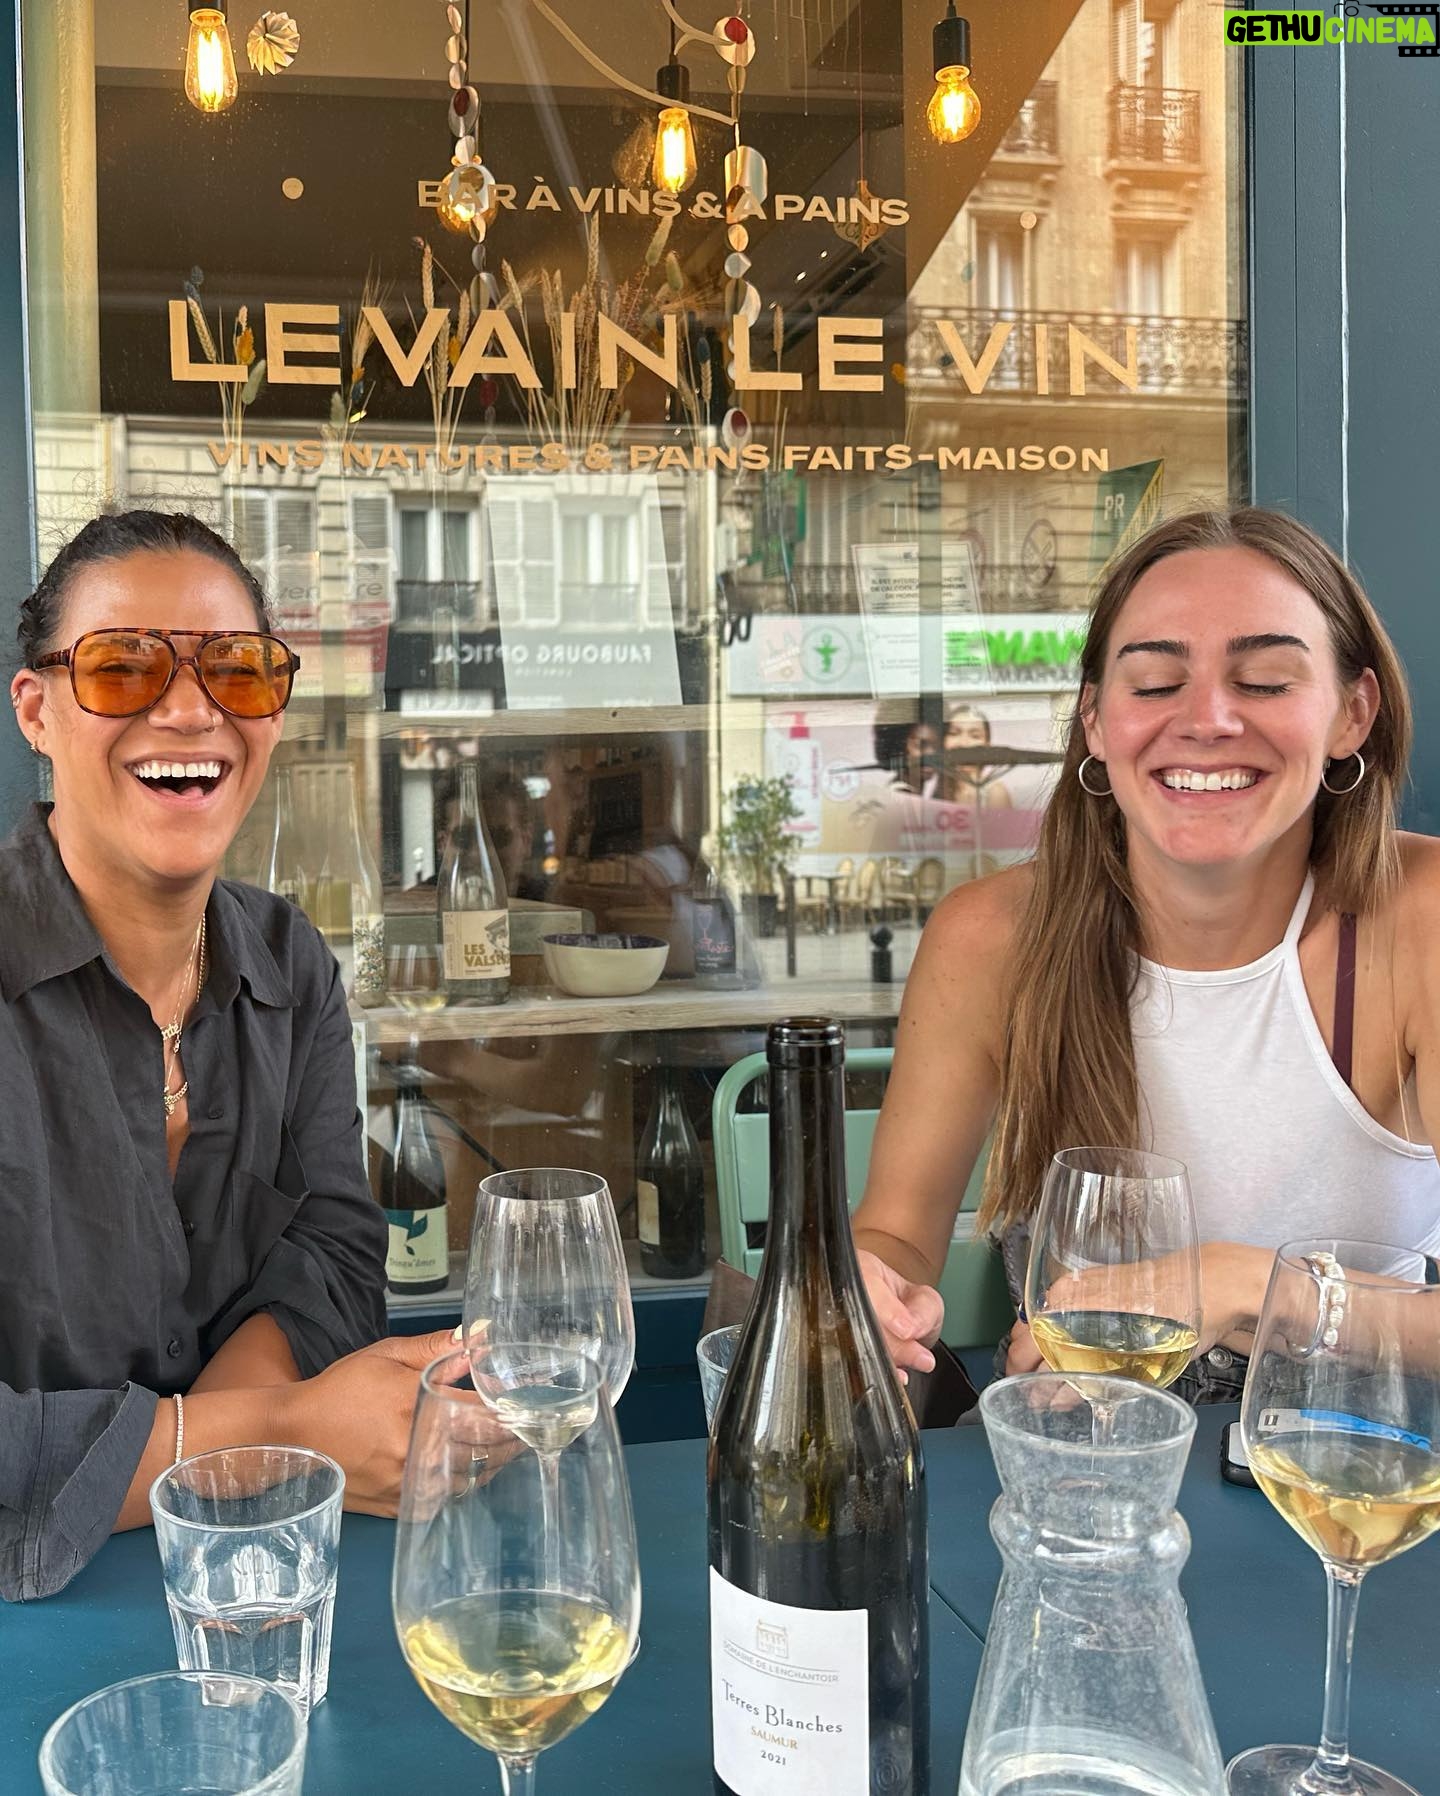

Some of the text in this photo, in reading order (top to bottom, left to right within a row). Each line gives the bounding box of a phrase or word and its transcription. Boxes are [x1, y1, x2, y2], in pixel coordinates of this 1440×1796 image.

[418, 180, 518, 210] BAR
[525, 175, 562, 212] À
[568, 186, 682, 217] VINS
[692, 191, 725, 219] &
[775, 194, 910, 226] PAINS
[732, 313, 884, 392] LE
[935, 319, 1138, 396] VIN
[207, 439, 1110, 472] VINS NATURES & PAINS FAITS-MAISON
[463, 943, 486, 956] LES
[721, 1678, 843, 1733] Terres Blanches
[750, 1725, 798, 1750] SAUMUR
[760, 1749, 787, 1766] 2021
